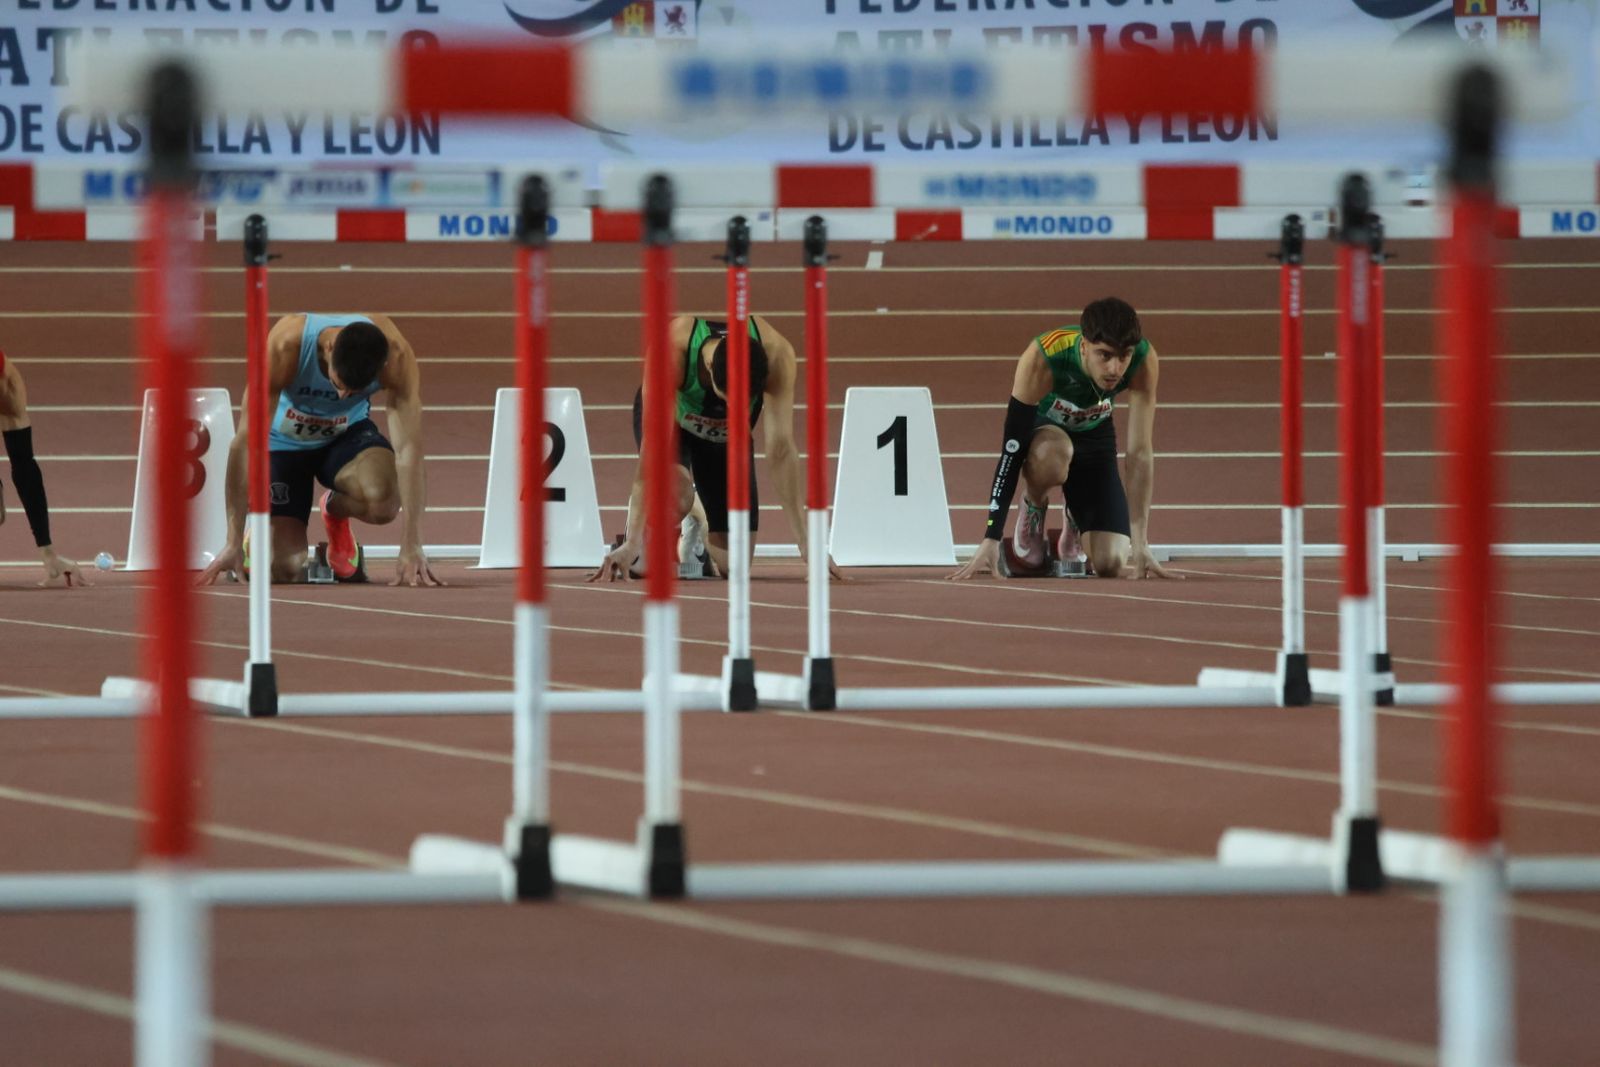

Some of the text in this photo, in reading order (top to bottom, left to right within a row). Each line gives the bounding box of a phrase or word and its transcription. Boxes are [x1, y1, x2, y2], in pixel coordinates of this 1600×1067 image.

[56, 104, 271, 154] CASLLA
[284, 110, 307, 155] Y
[828, 109, 885, 152] DE
[439, 214, 558, 236] MONO
[1015, 215, 1112, 234] MONDO
[293, 423, 335, 437] 196
[521, 421, 566, 502] 2
[876, 415, 908, 496] 1
